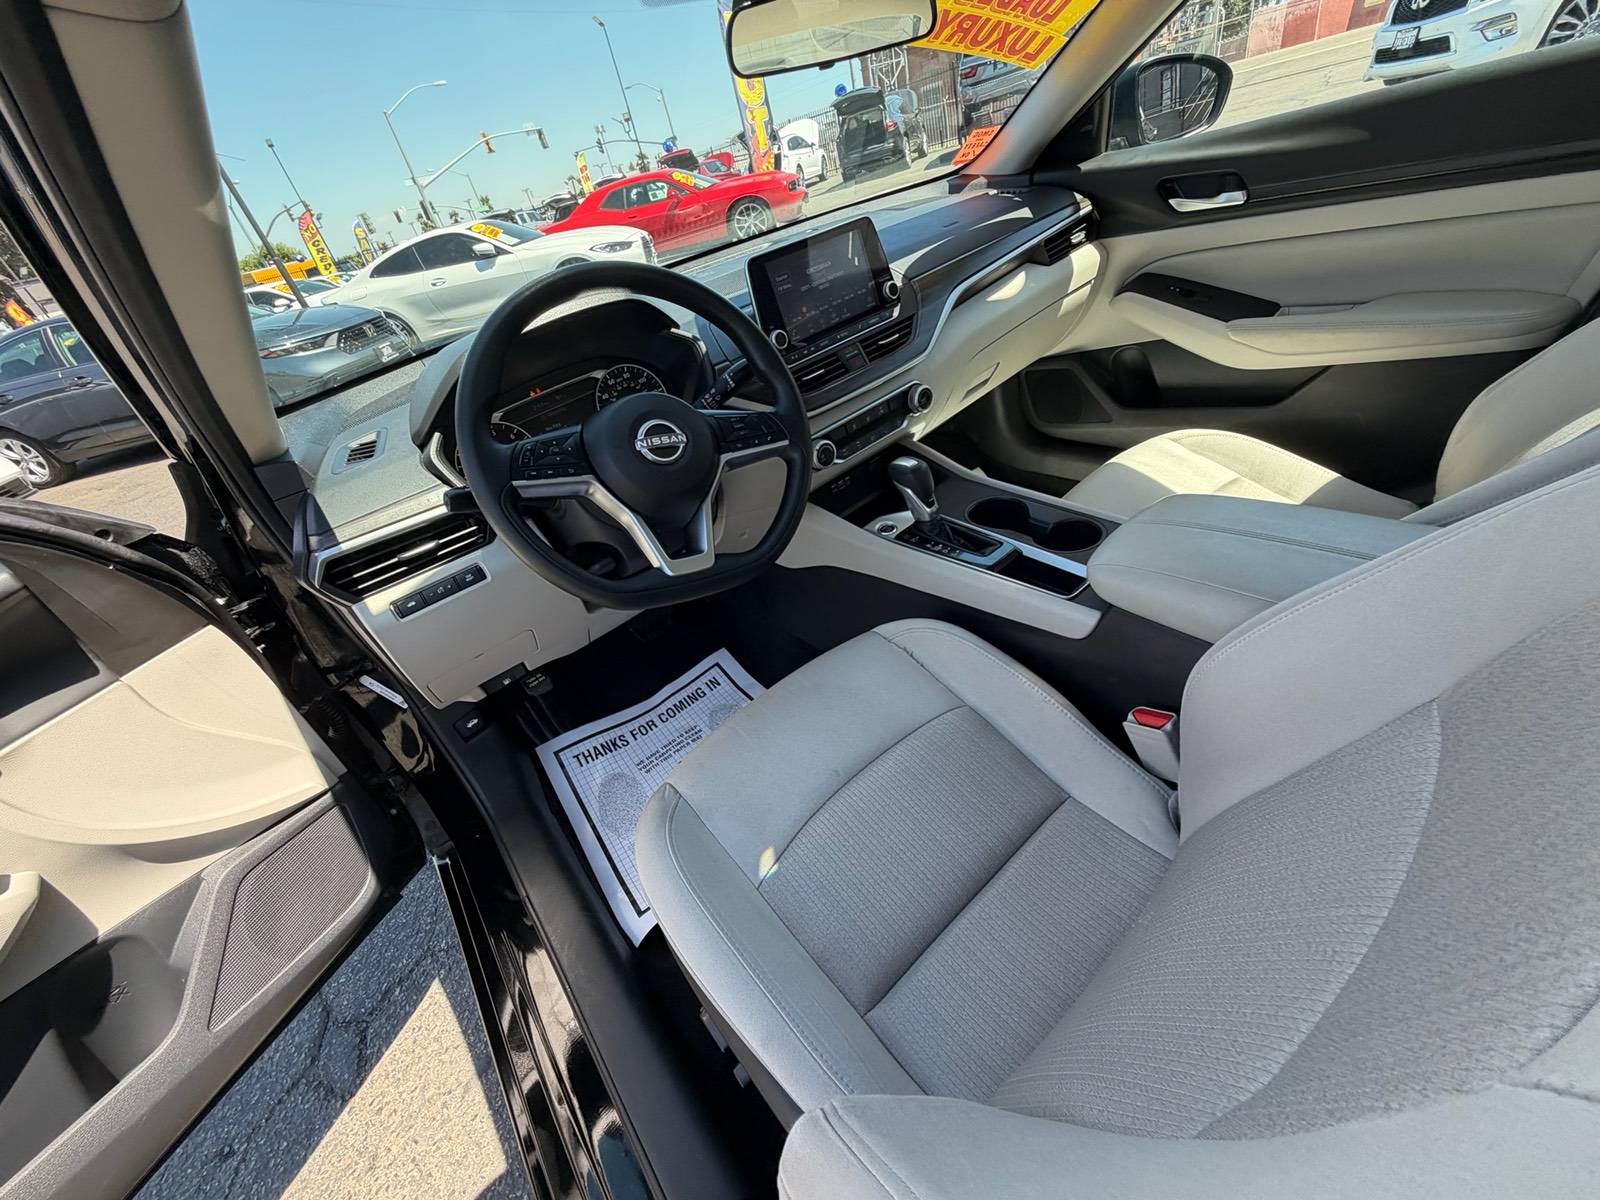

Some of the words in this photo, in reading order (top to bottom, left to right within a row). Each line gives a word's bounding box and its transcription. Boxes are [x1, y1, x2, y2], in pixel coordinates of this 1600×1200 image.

[303, 223, 317, 241] NO
[311, 239, 333, 274] CRED
[636, 433, 688, 451] NISSAN
[572, 734, 630, 768] THANKS
[629, 719, 658, 742] FOR
[658, 687, 706, 724] COMING
[706, 677, 722, 692] IN
[660, 738, 677, 751] TRIED
